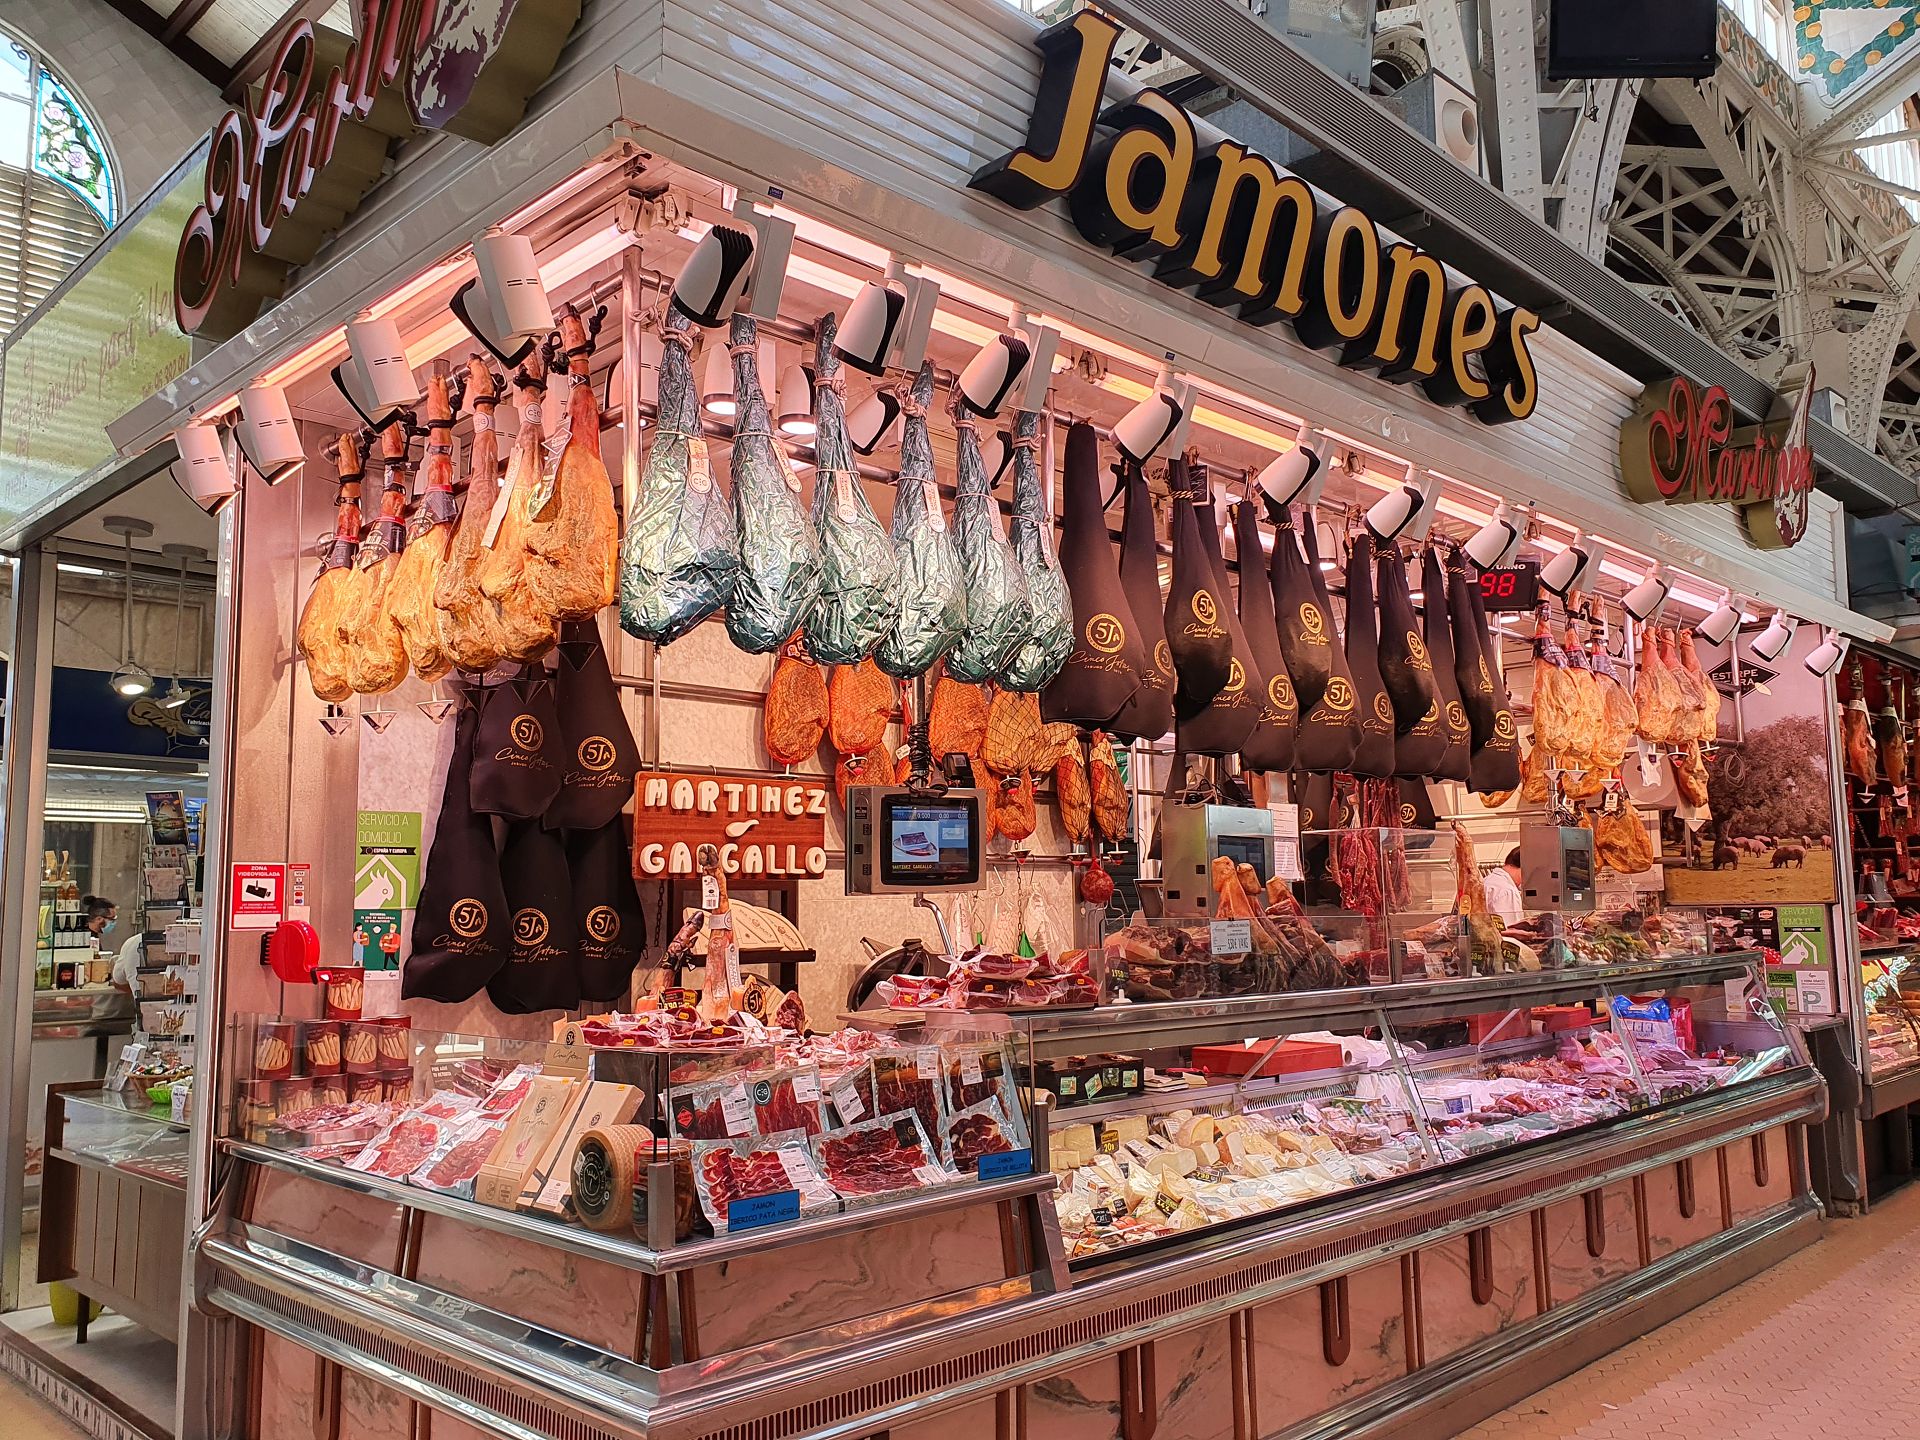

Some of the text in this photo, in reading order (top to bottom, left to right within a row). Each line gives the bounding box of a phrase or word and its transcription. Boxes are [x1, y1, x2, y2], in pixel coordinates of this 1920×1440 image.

[1008, 10, 1541, 420] Jamones
[1480, 573, 1516, 597] 98
[1094, 622, 1116, 645] 5J
[1068, 651, 1105, 664] Cinco
[1330, 684, 1346, 704] 5J
[1311, 709, 1342, 722] Cinco
[519, 722, 535, 744] 5J
[495, 747, 529, 760] Cinco
[586, 744, 606, 764] 5J
[645, 778, 827, 816] MARTINEZ
[359, 813, 409, 826] SERVICIO A
[358, 831, 402, 844] DOMICILIO
[457, 907, 479, 929] 5J
[518, 916, 539, 938] 5J
[594, 913, 612, 935] 5J
[432, 933, 466, 947] Cinco
[751, 1201, 776, 1210] JAMON
[730, 1207, 799, 1225] IBERICO PATA NEGRA
